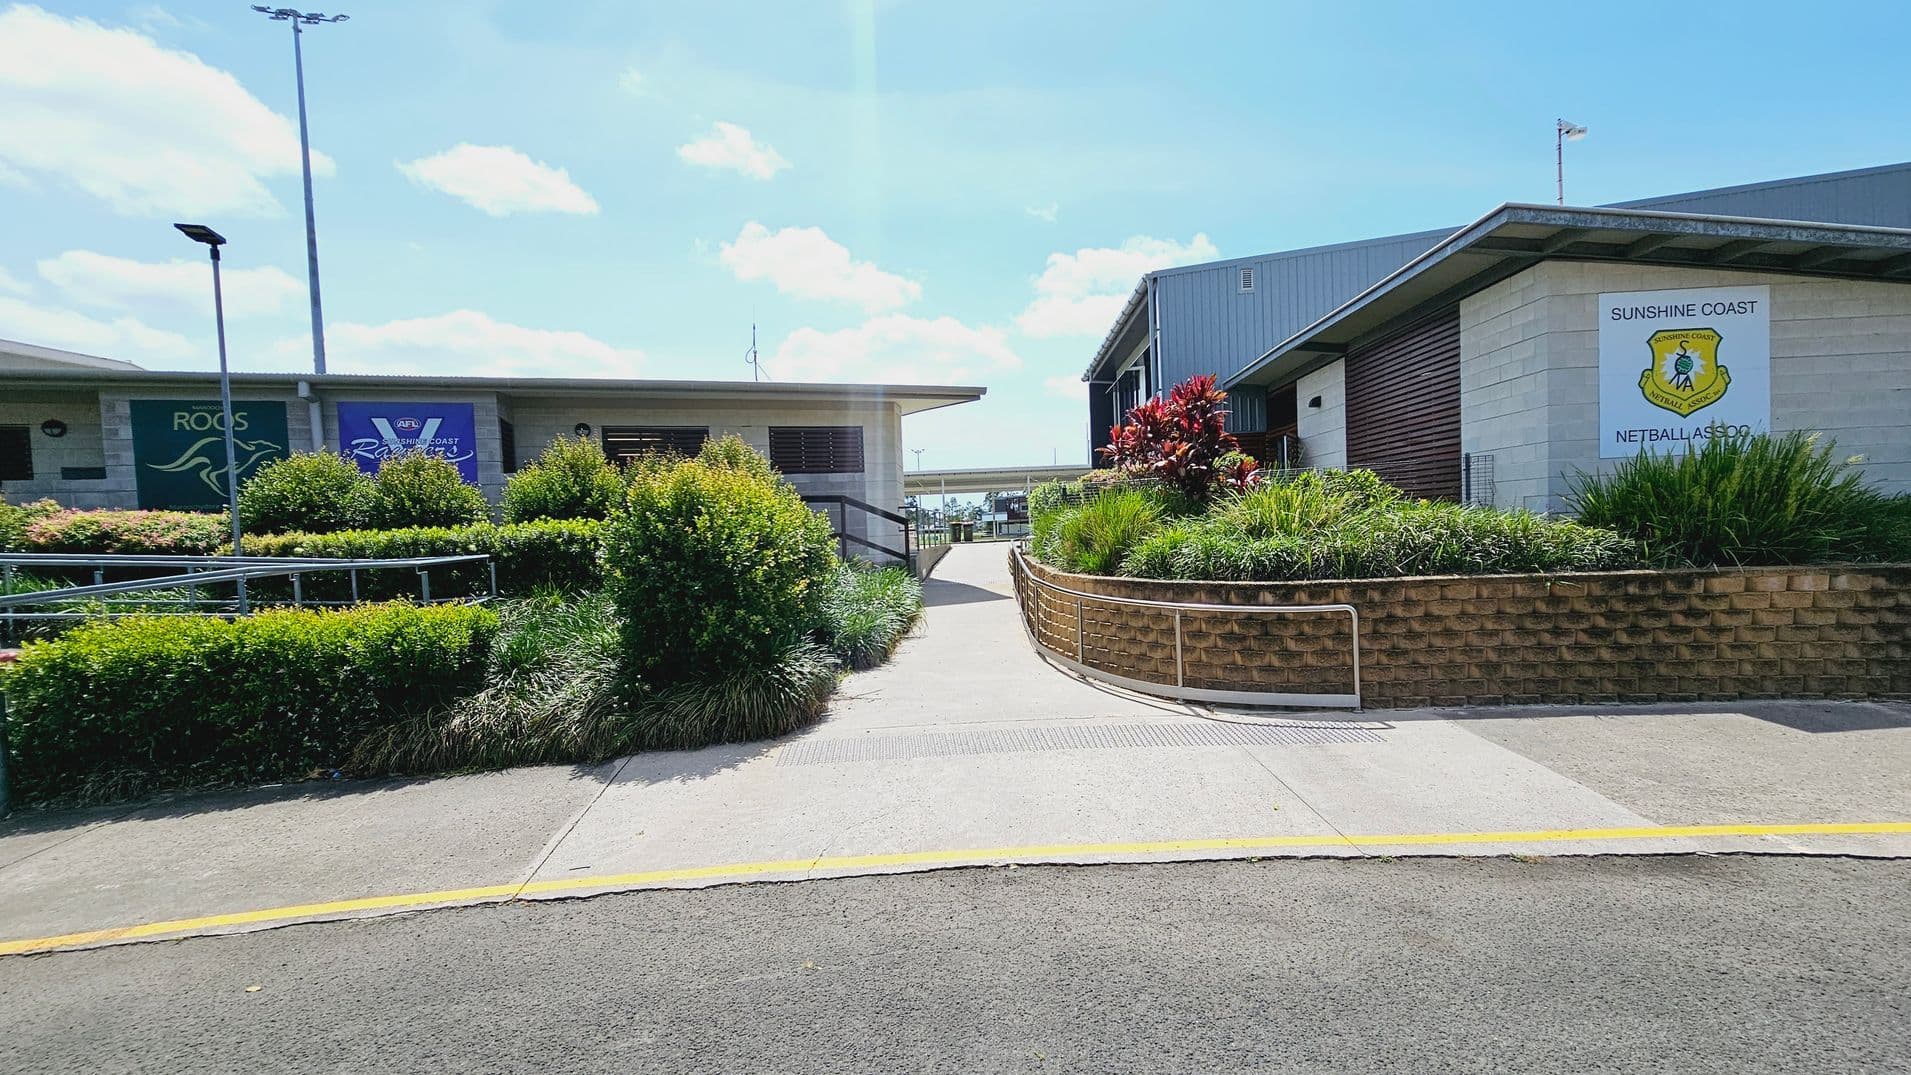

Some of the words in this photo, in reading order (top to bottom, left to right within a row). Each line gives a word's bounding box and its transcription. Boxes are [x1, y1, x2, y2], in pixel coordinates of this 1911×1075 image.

[1611, 303, 1696, 321] SUNSHINE
[1701, 301, 1758, 317] COAST
[1654, 333, 1690, 344] SUNSHINE
[1691, 332, 1716, 341] COAST
[1649, 390, 1683, 410] NETBALL
[173, 411, 249, 431] ROOS
[396, 420, 419, 428] AFL
[1616, 427, 1688, 443] NETBALL
